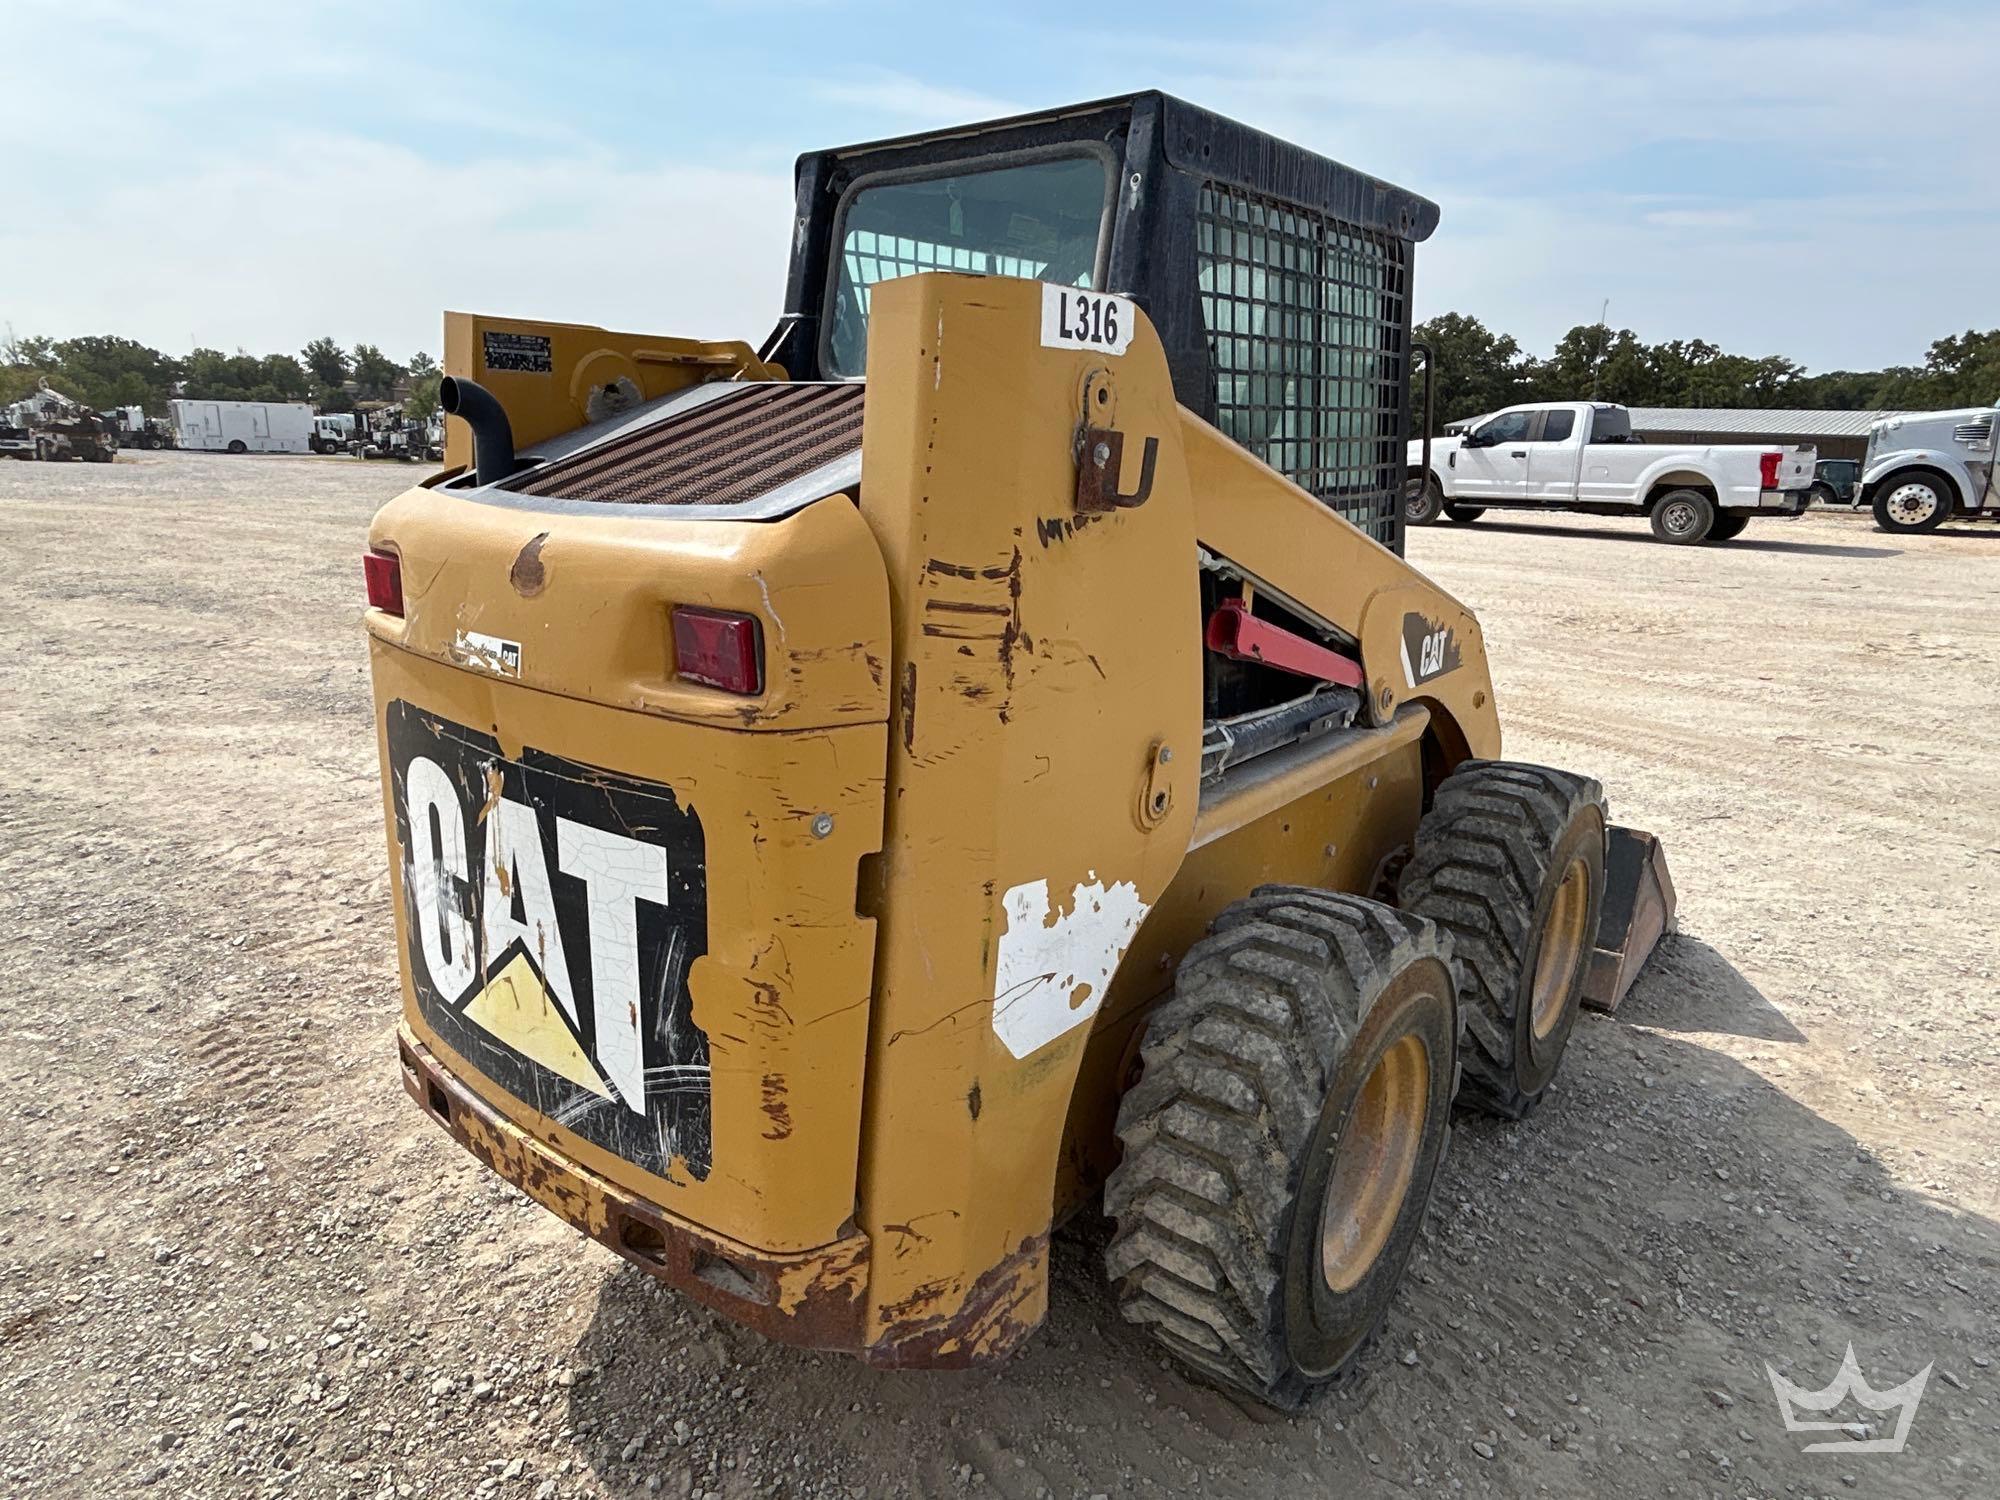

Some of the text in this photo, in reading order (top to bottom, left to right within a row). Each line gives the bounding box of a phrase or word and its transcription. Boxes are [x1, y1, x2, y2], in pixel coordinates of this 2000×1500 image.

[1060, 292, 1118, 345] L316
[502, 649, 518, 667] CAT
[1420, 630, 1447, 677] CAT
[407, 756, 669, 1116] CAT
